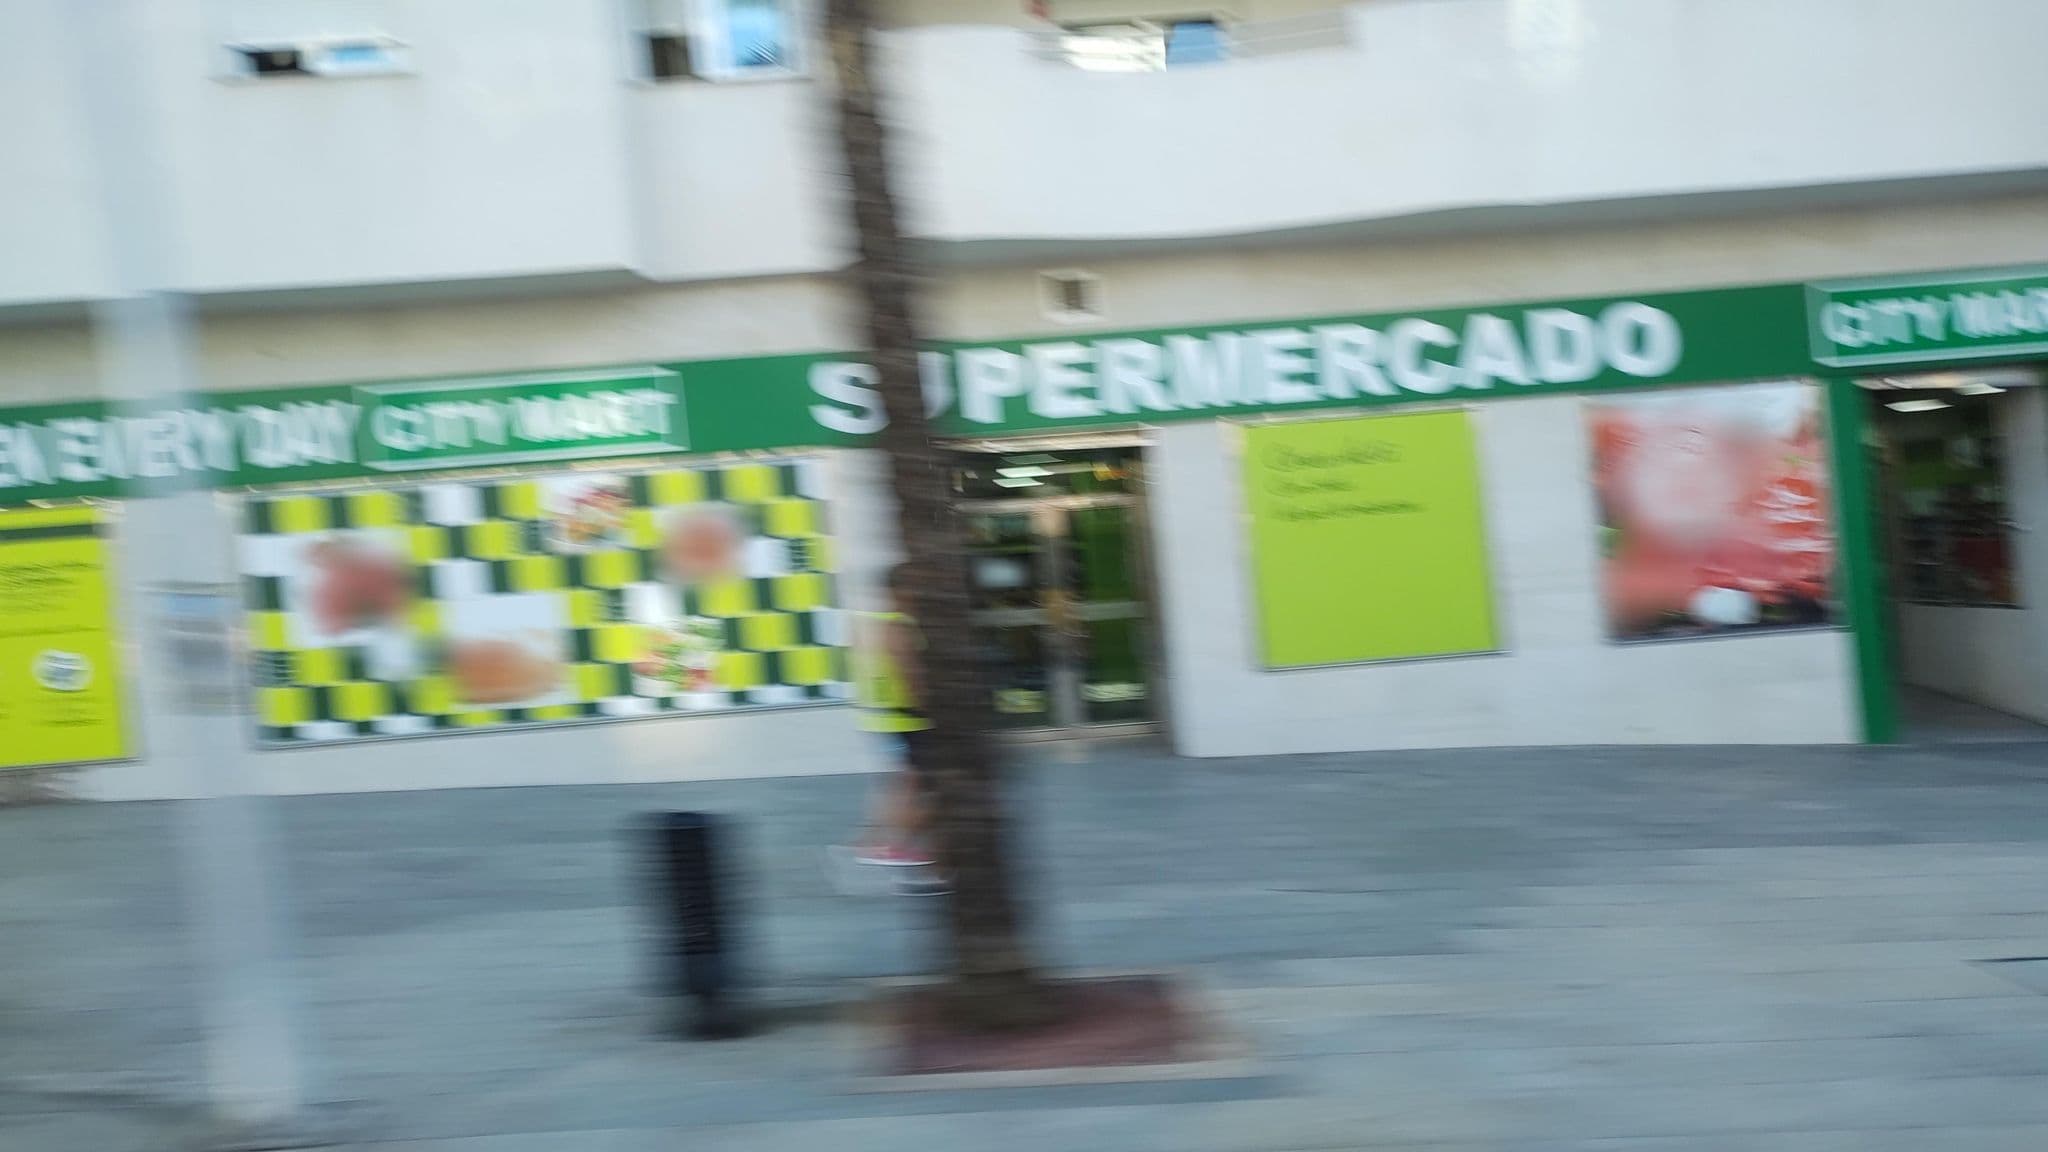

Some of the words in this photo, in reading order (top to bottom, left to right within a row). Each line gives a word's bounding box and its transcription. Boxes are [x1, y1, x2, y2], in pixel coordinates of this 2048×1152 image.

[1819, 294, 1949, 348] CITY
[44, 406, 241, 483] EVERY
[237, 399, 361, 468] DAY
[371, 401, 508, 451] CITY
[508, 388, 680, 442] MART
